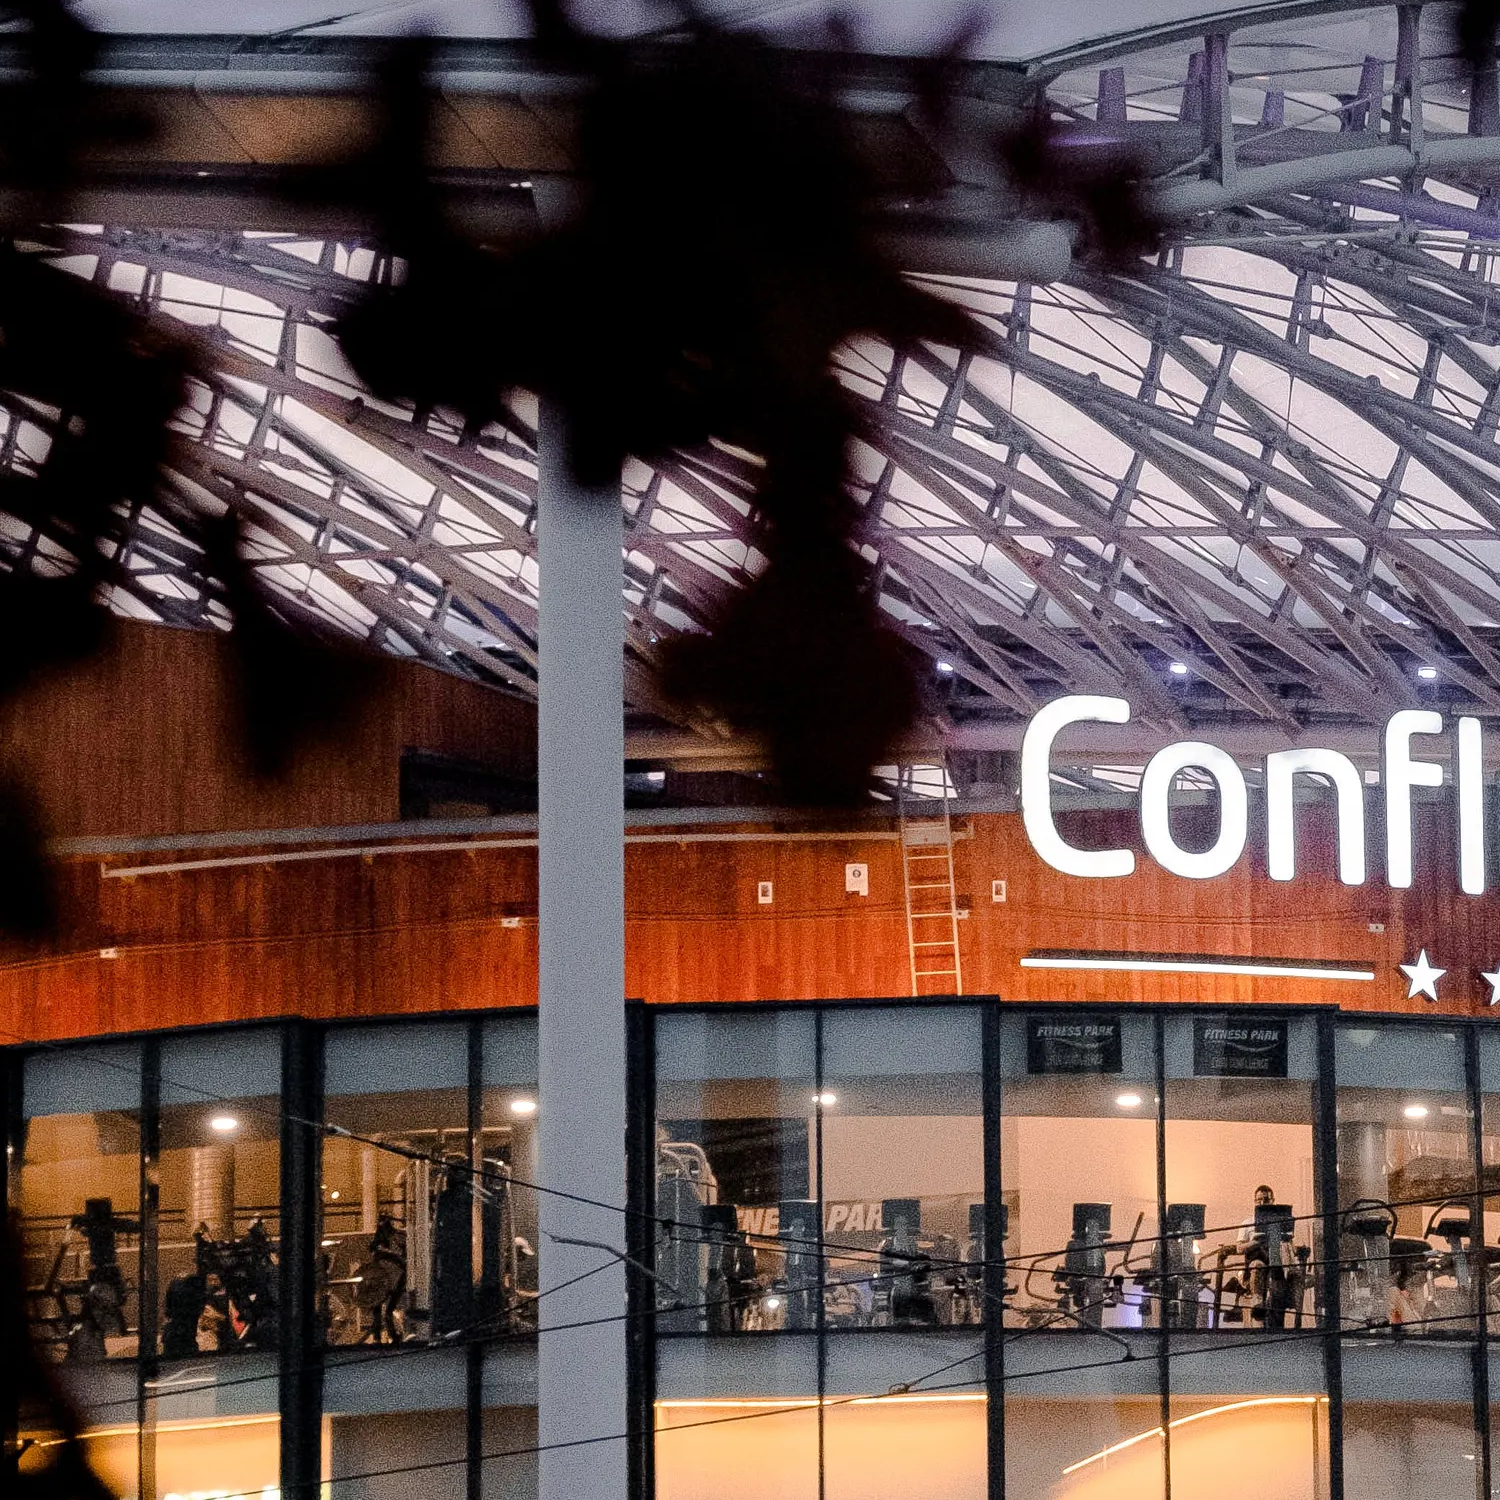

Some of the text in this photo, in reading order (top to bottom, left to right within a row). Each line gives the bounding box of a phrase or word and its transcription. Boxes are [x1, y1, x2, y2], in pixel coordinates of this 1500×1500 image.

[1036, 1025, 1115, 1038] FITNESS PARK
[1203, 1028, 1280, 1042] FITNESS PARK
